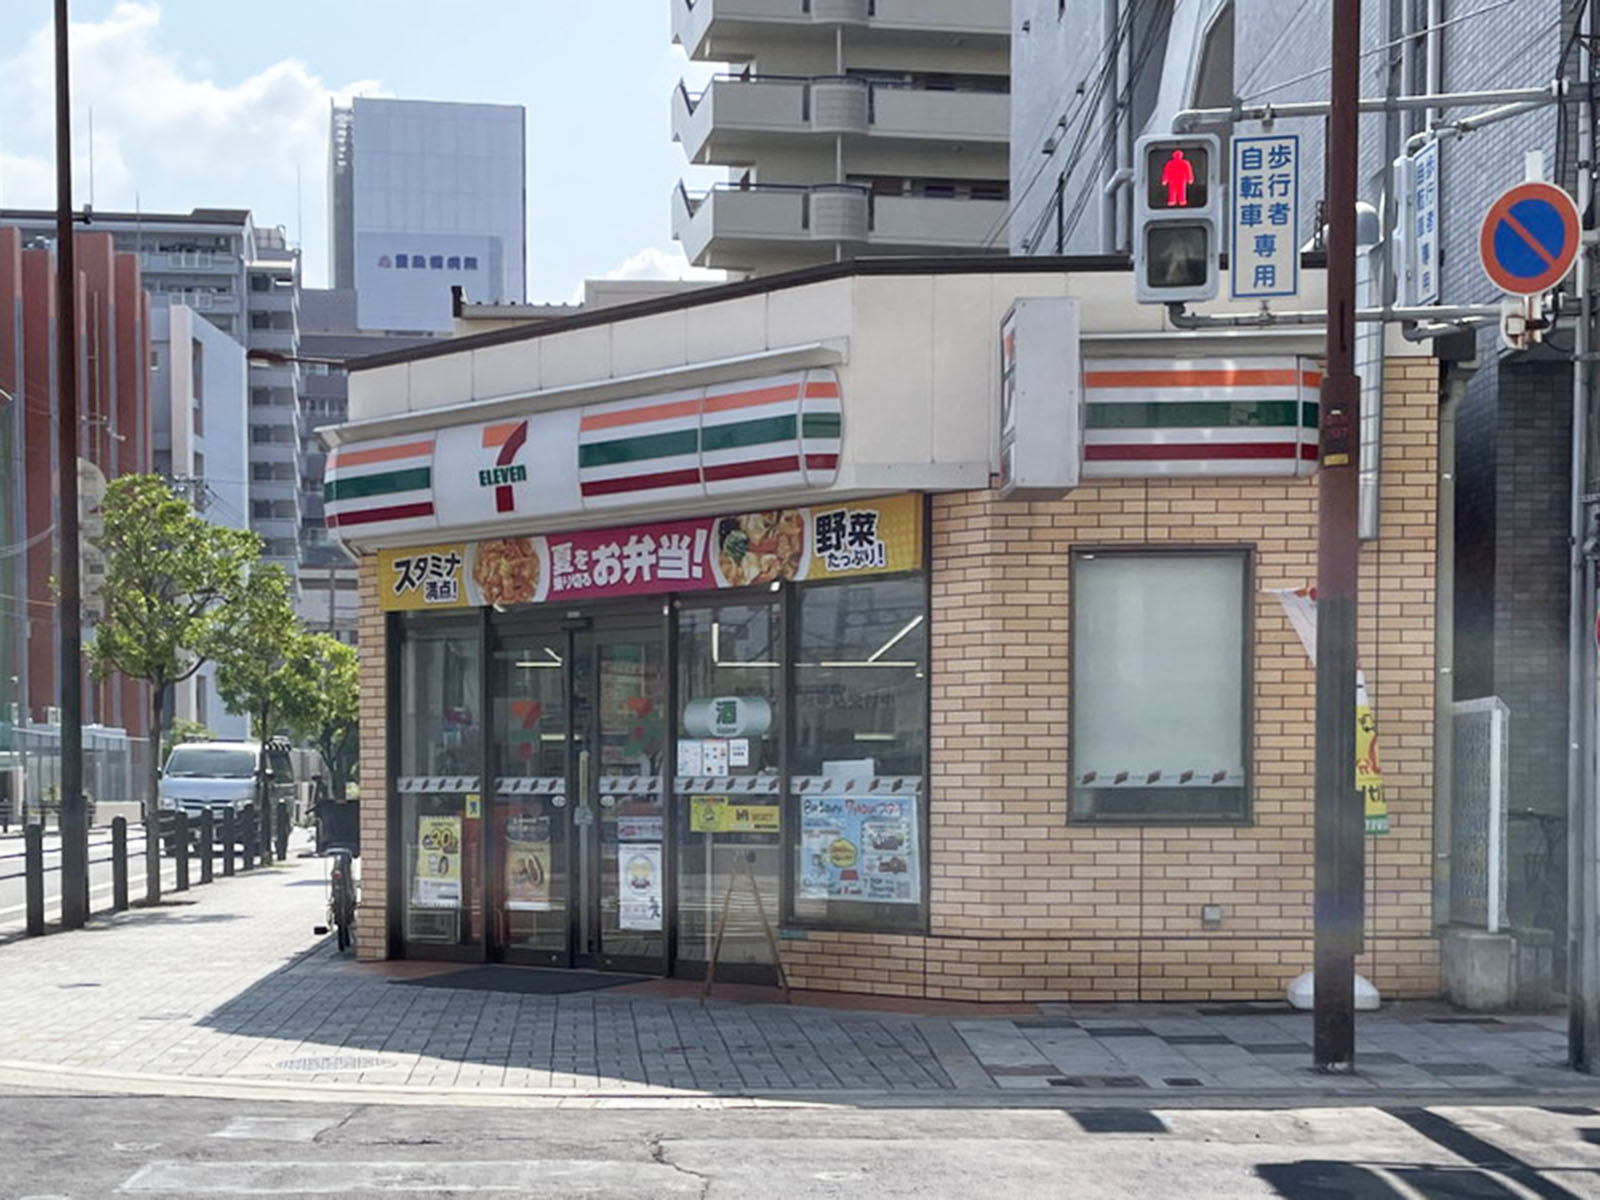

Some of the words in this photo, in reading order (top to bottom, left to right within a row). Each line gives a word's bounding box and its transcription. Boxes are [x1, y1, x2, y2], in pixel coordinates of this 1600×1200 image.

[1240, 147, 1262, 227] 自転車
[1268, 144, 1291, 225] 歩行者
[1253, 234, 1276, 288] 専用
[816, 511, 876, 554] 野菜
[828, 543, 883, 568] たっぷり!
[394, 552, 460, 592] スタミナ
[592, 528, 708, 587] お弁当!
[715, 700, 737, 725] 酒
